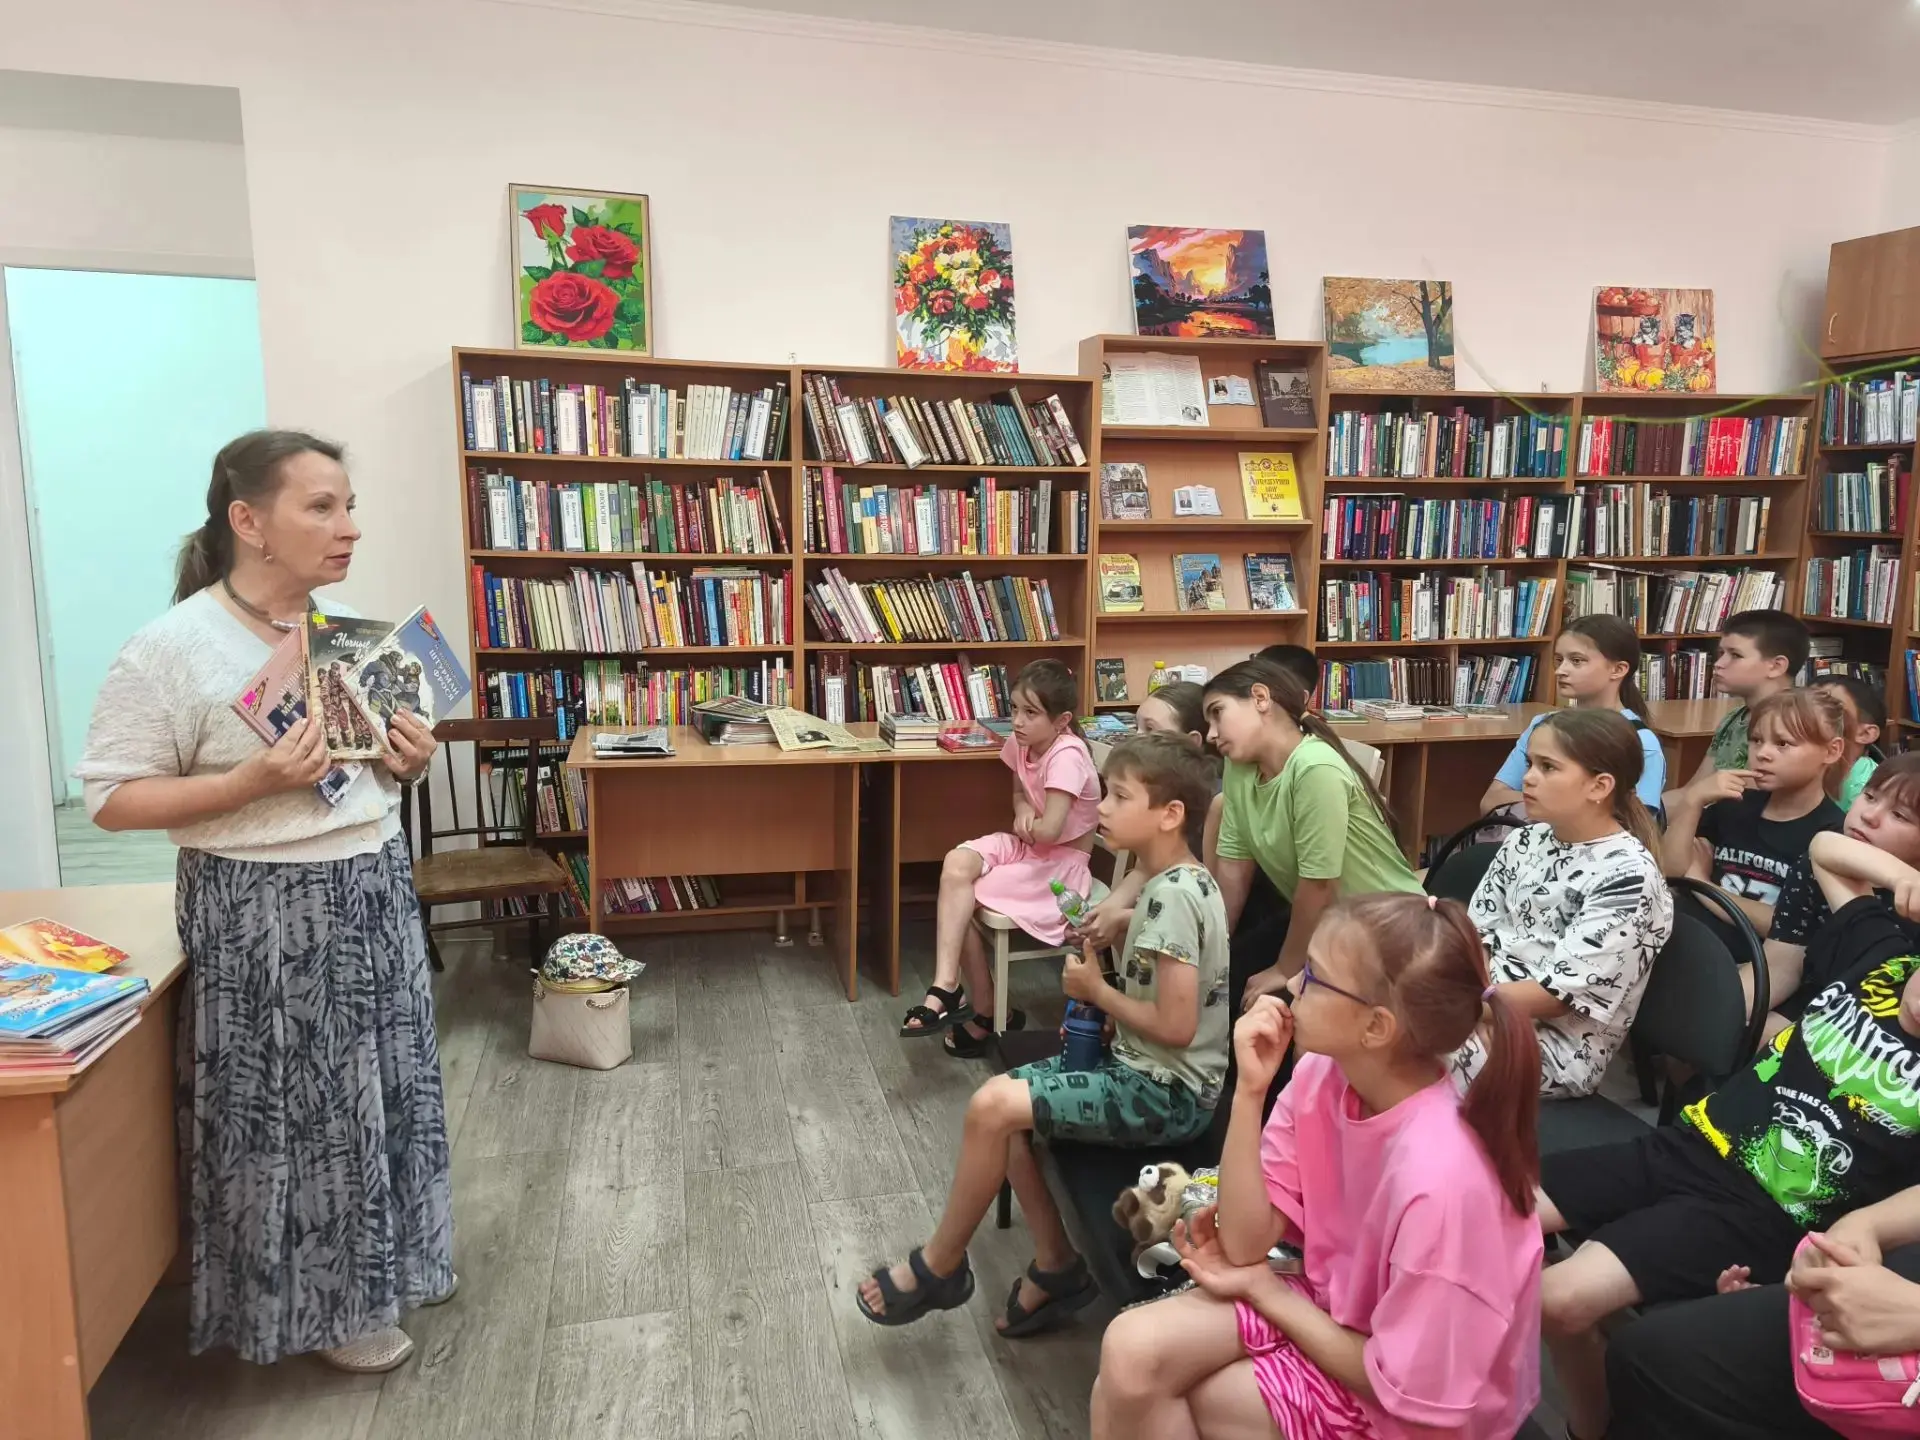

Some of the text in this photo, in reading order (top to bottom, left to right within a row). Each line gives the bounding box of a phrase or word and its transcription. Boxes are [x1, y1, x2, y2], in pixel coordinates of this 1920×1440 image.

[429, 649, 460, 696] ШТУРМАН
[433, 669, 455, 702] ФРОСЯ
[1775, 1086, 1843, 1131] TIME HAS COME
